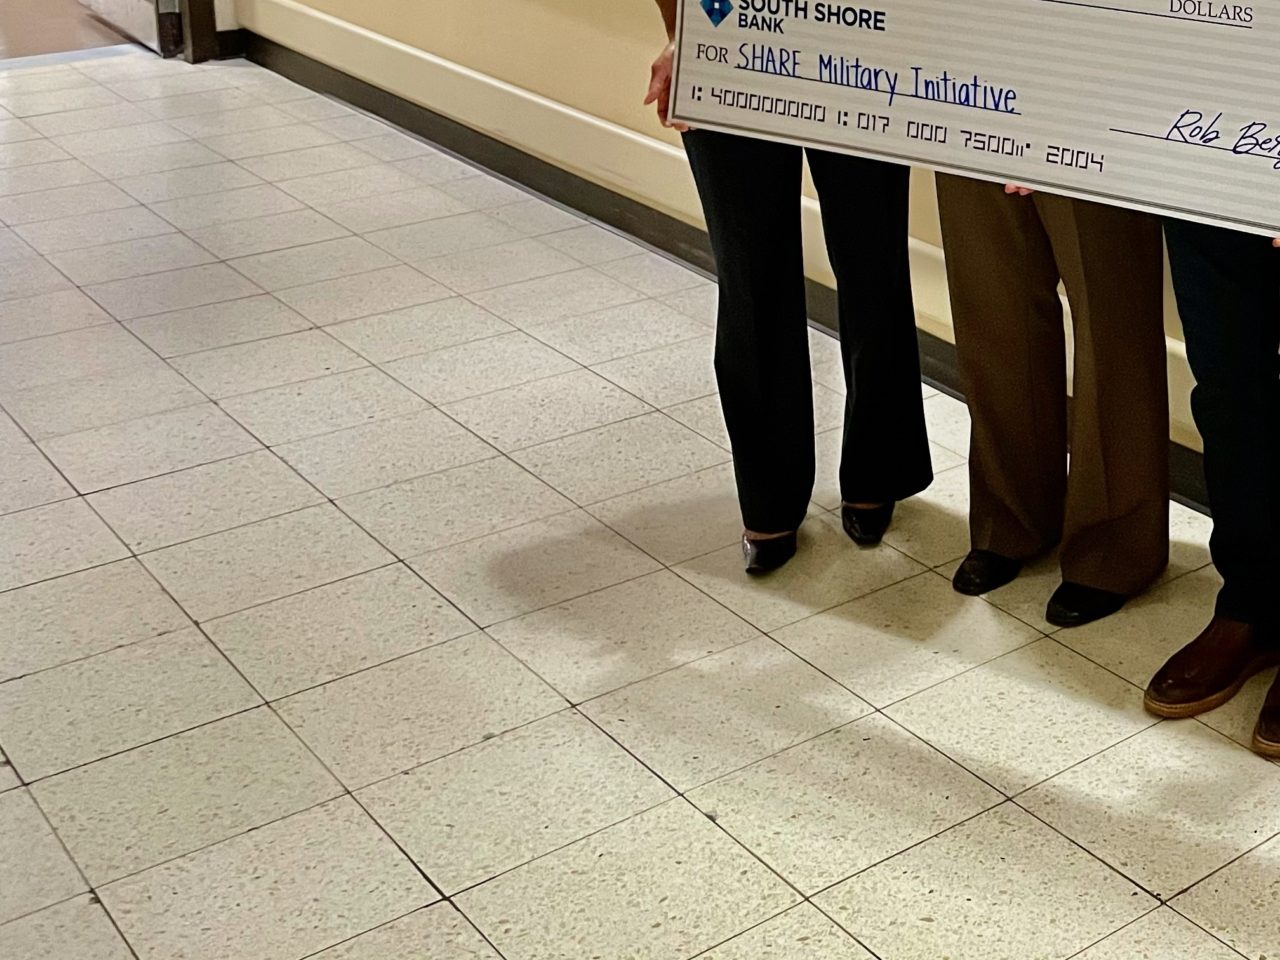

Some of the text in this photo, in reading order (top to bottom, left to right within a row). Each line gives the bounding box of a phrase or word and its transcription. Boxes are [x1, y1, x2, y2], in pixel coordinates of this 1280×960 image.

[738, 13, 785, 34] BANK
[814, 2, 886, 31] SHORE
[695, 43, 729, 64] FOR
[819, 53, 898, 106] Military
[911, 67, 1017, 113] Initiative
[1166, 109, 1222, 143] Rob
[857, 112, 890, 134] 017
[906, 120, 948, 144] 000
[1046, 144, 1104, 173] 2004
